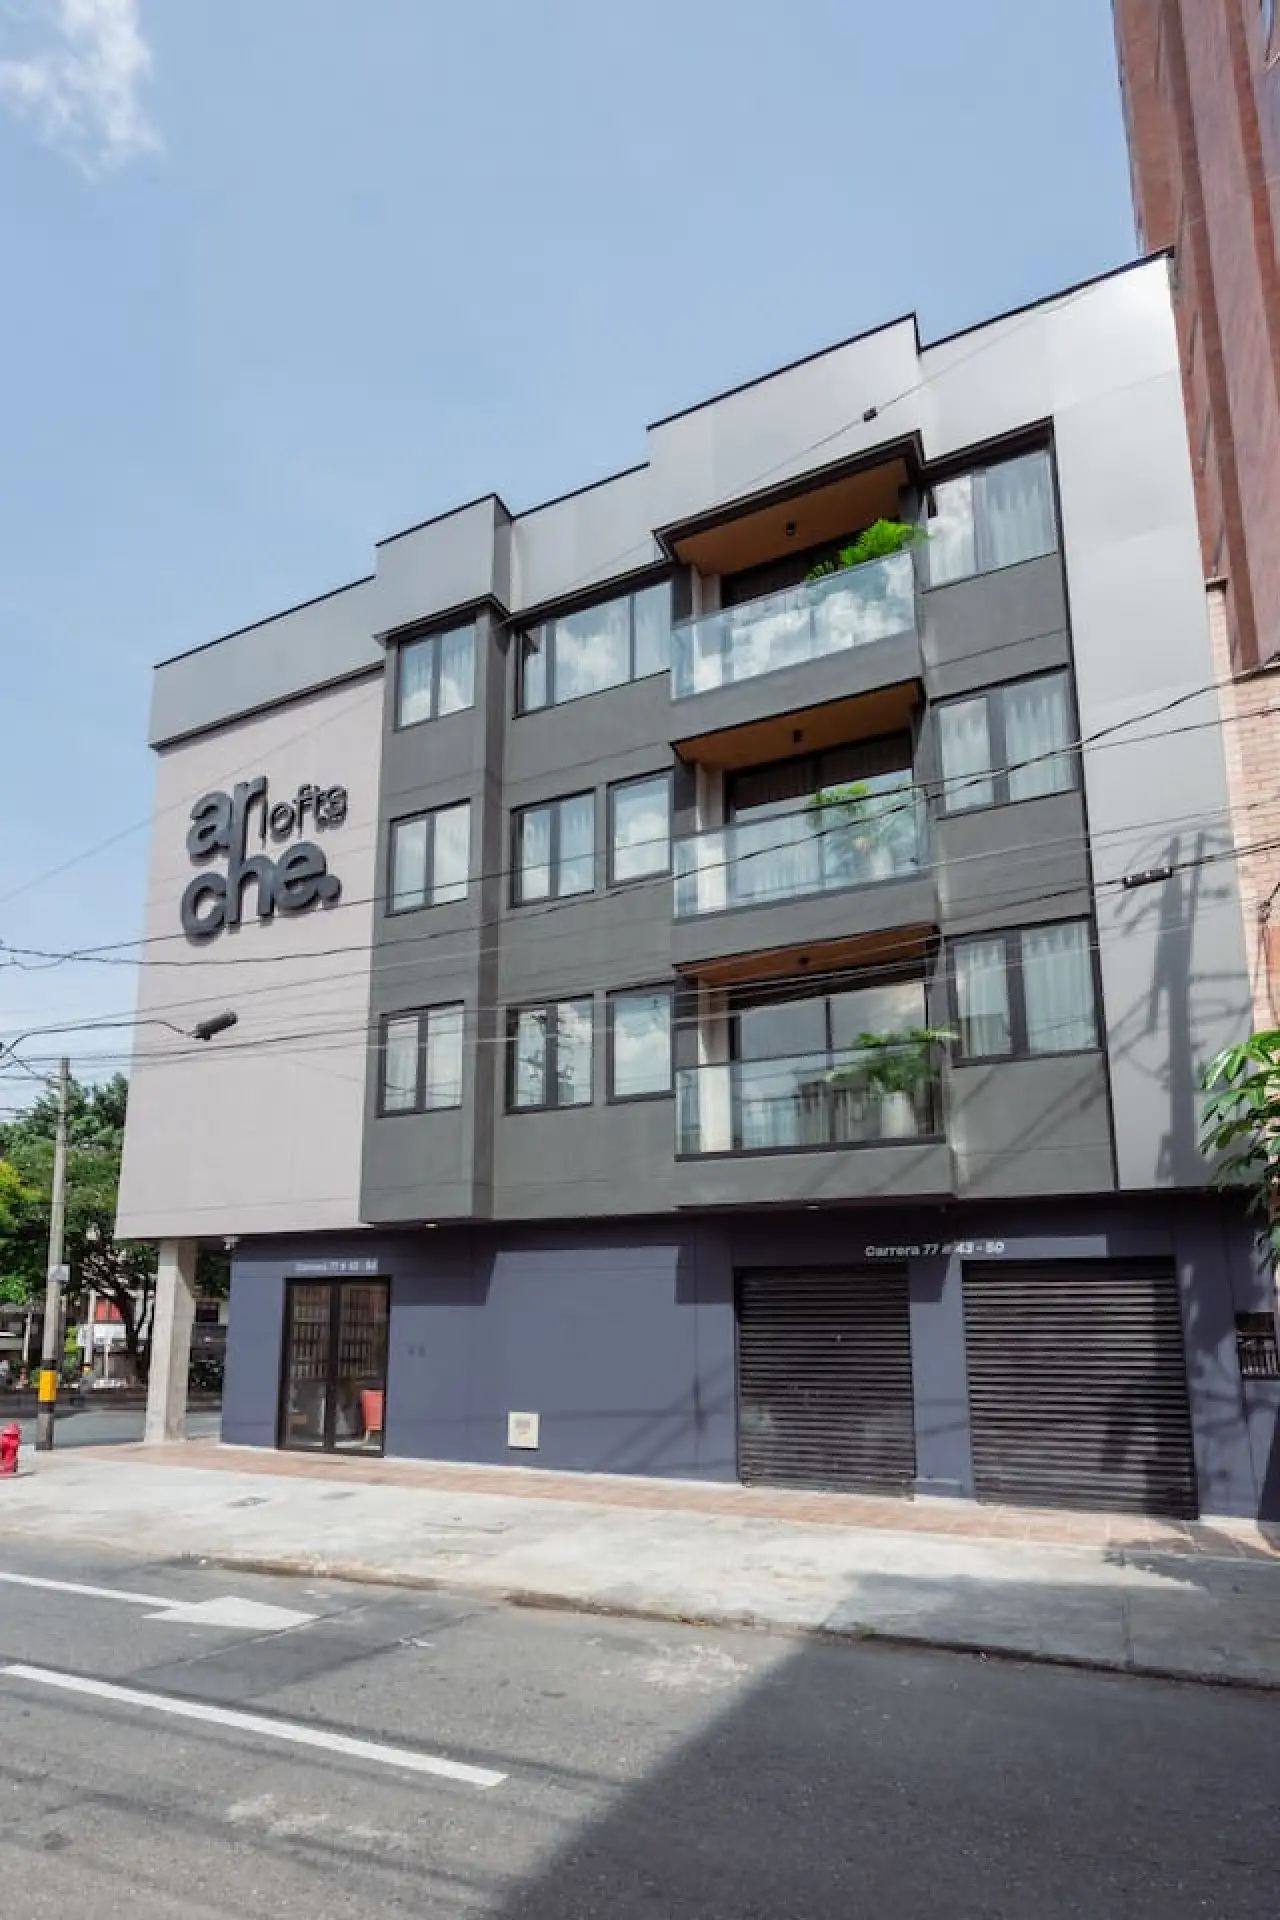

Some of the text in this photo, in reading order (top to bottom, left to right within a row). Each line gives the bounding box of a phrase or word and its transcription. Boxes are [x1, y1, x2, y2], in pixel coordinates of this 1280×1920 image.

[259, 784, 348, 846] lofts
[865, 1245, 920, 1257] Carrera
[921, 1243, 939, 1256] 77
